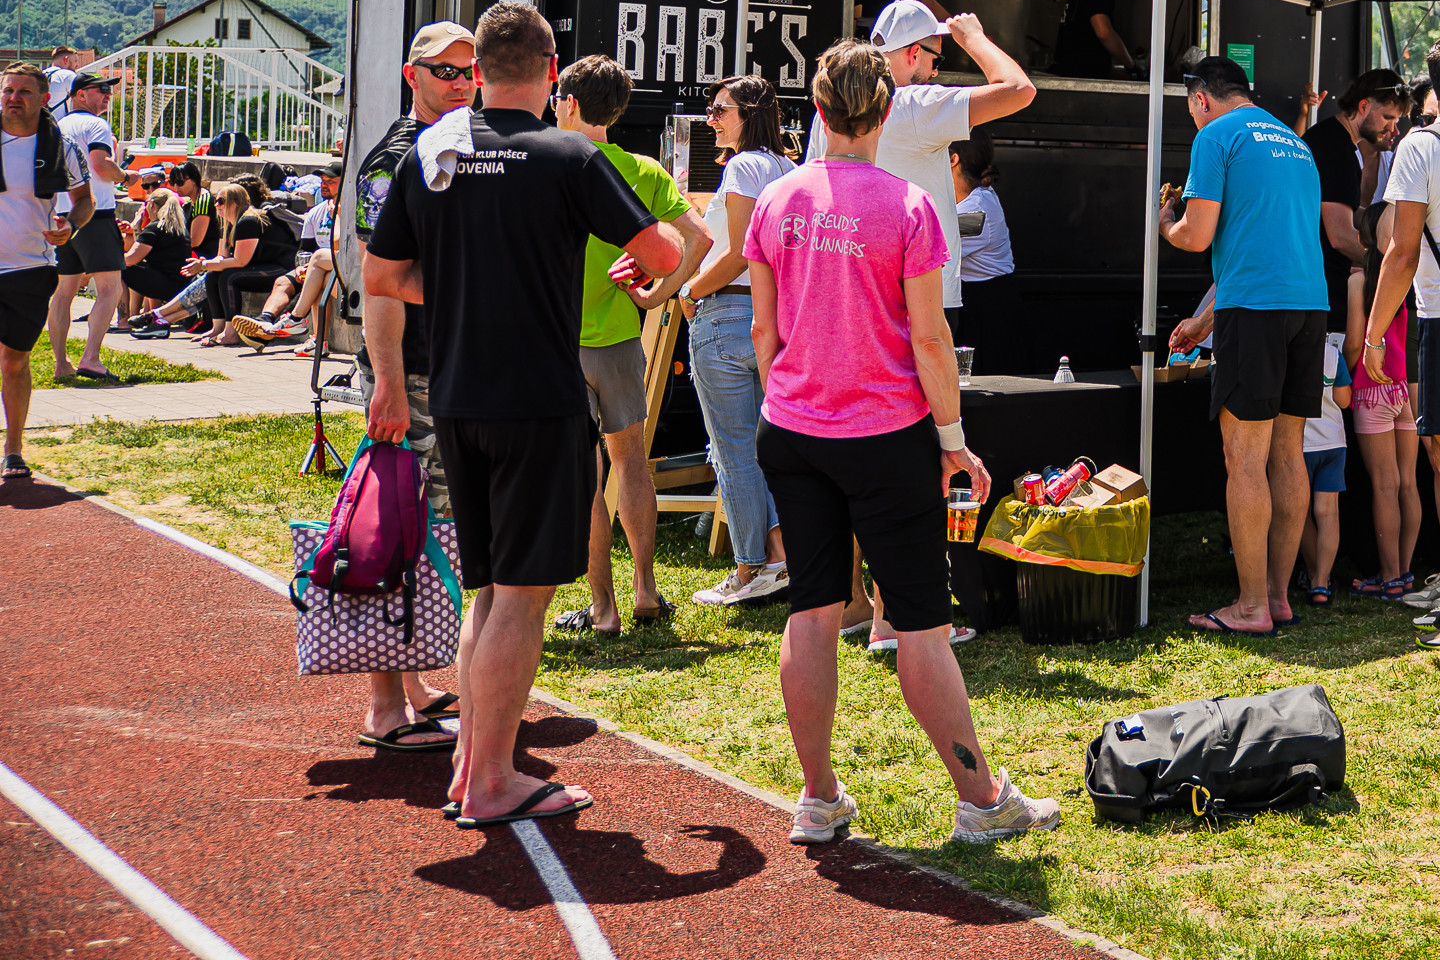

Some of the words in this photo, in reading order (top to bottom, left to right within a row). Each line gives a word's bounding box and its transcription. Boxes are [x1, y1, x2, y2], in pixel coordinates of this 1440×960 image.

[678, 85, 710, 98] KITC
[1252, 131, 1294, 146] Brežice
[475, 150, 498, 159] KLUB
[498, 148, 528, 160] PIŠECE
[456, 161, 505, 175] OVENIA
[811, 212, 861, 233] FREUD'S
[810, 236, 866, 258] RUNNERS
